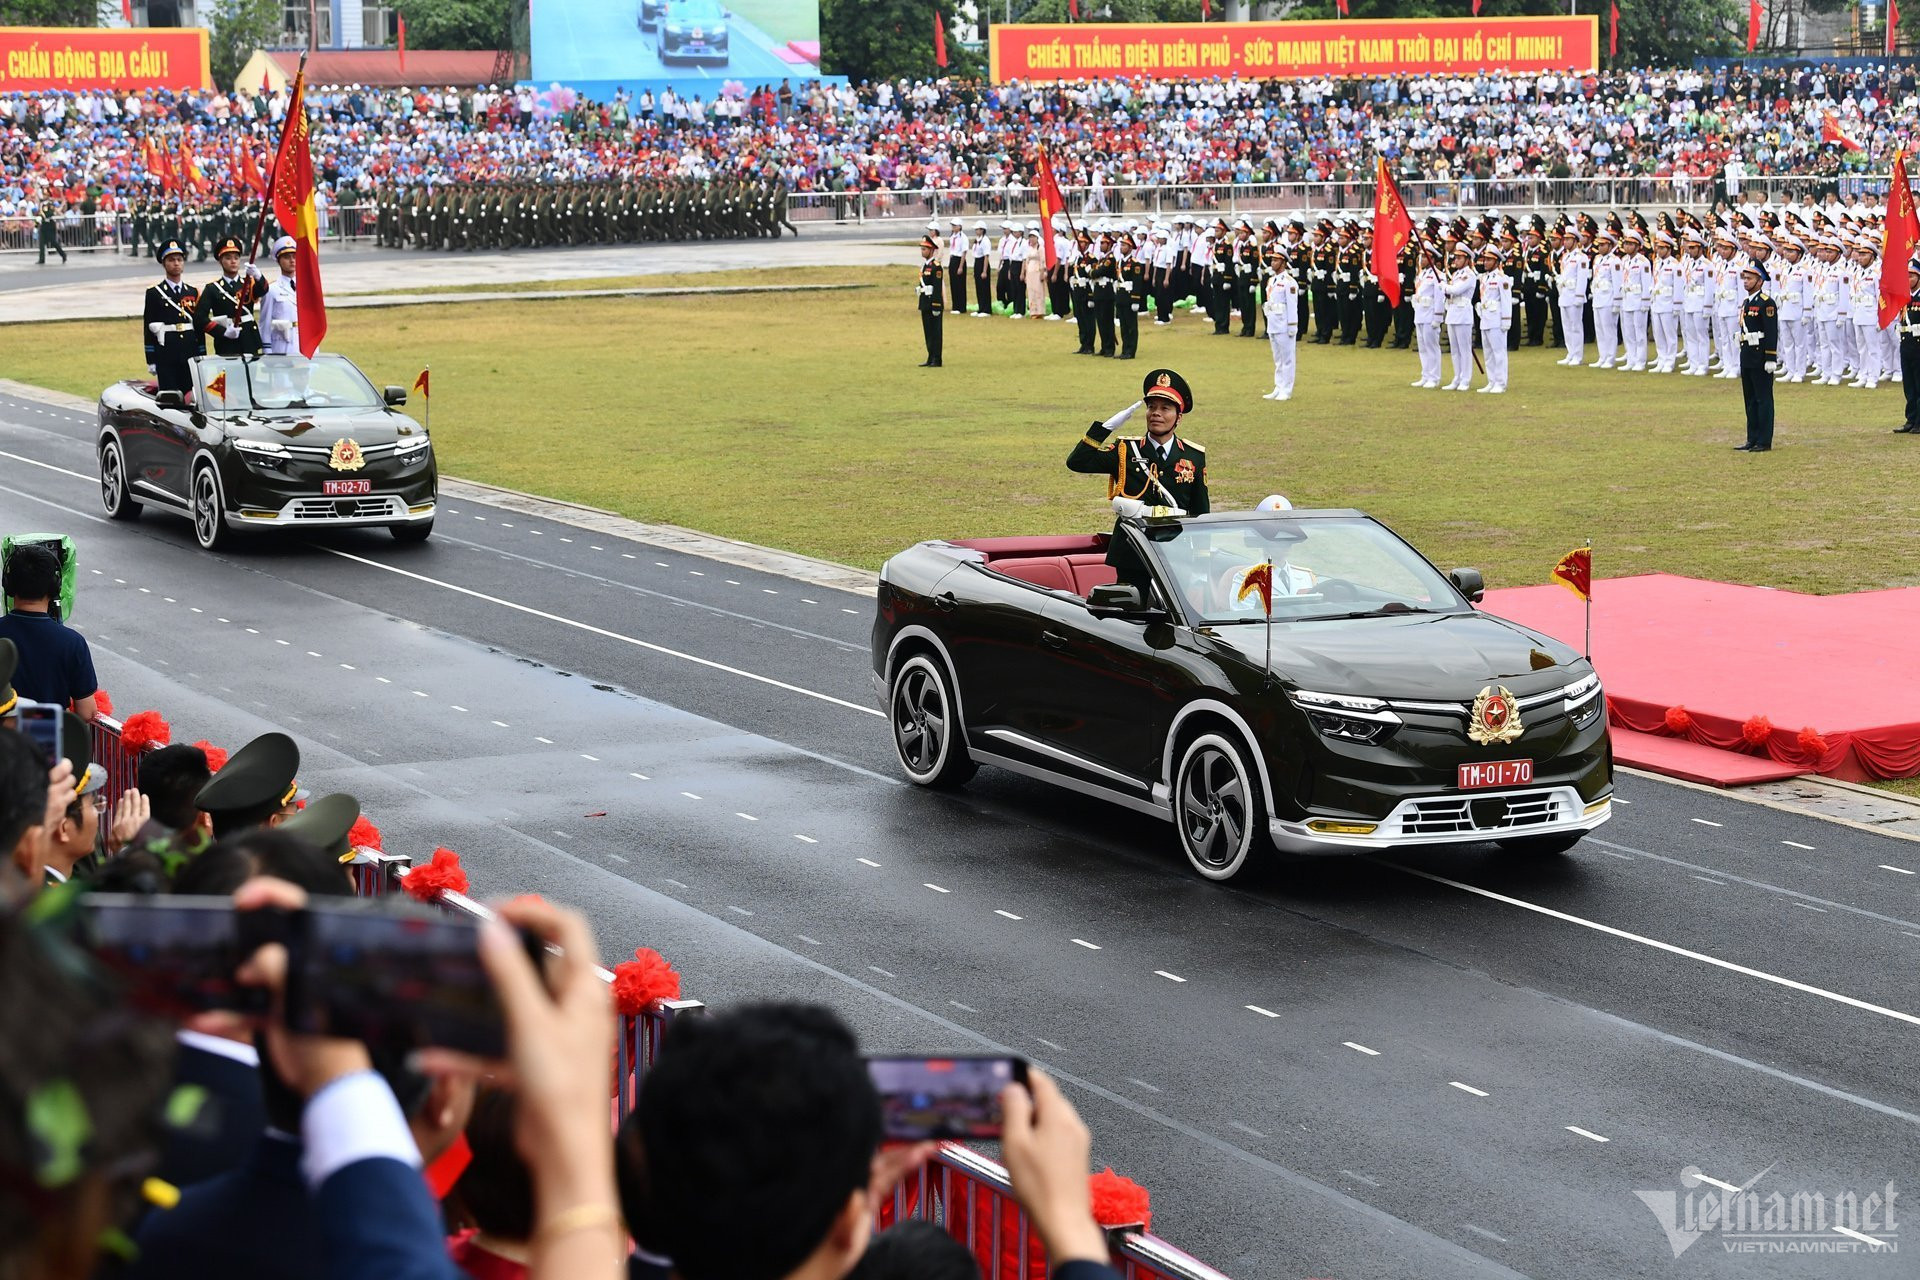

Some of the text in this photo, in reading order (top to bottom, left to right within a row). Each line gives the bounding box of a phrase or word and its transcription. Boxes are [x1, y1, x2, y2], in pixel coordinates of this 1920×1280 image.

[8, 42, 50, 78] CHẤN
[54, 46, 96, 84] ĐỘNG
[100, 51, 126, 84] ĐỊA
[1027, 36, 1071, 69] CHIẾN
[1074, 36, 1122, 68] THẮNG
[1125, 39, 1159, 73] ĐIỆN
[1163, 39, 1197, 67] BIÊN
[1201, 35, 1230, 66] PHỦ
[1244, 37, 1273, 66] SỨC
[1277, 40, 1321, 70] MẠNH
[1324, 35, 1356, 68] VIỆT
[1359, 39, 1393, 63] NAM
[1397, 33, 1430, 62] THỜI
[1433, 38, 1458, 67] ĐẠI
[1486, 32, 1511, 61] CHÍ
[325, 482, 370, 494] TM-02-70
[1461, 762, 1530, 786] TM-01-70
